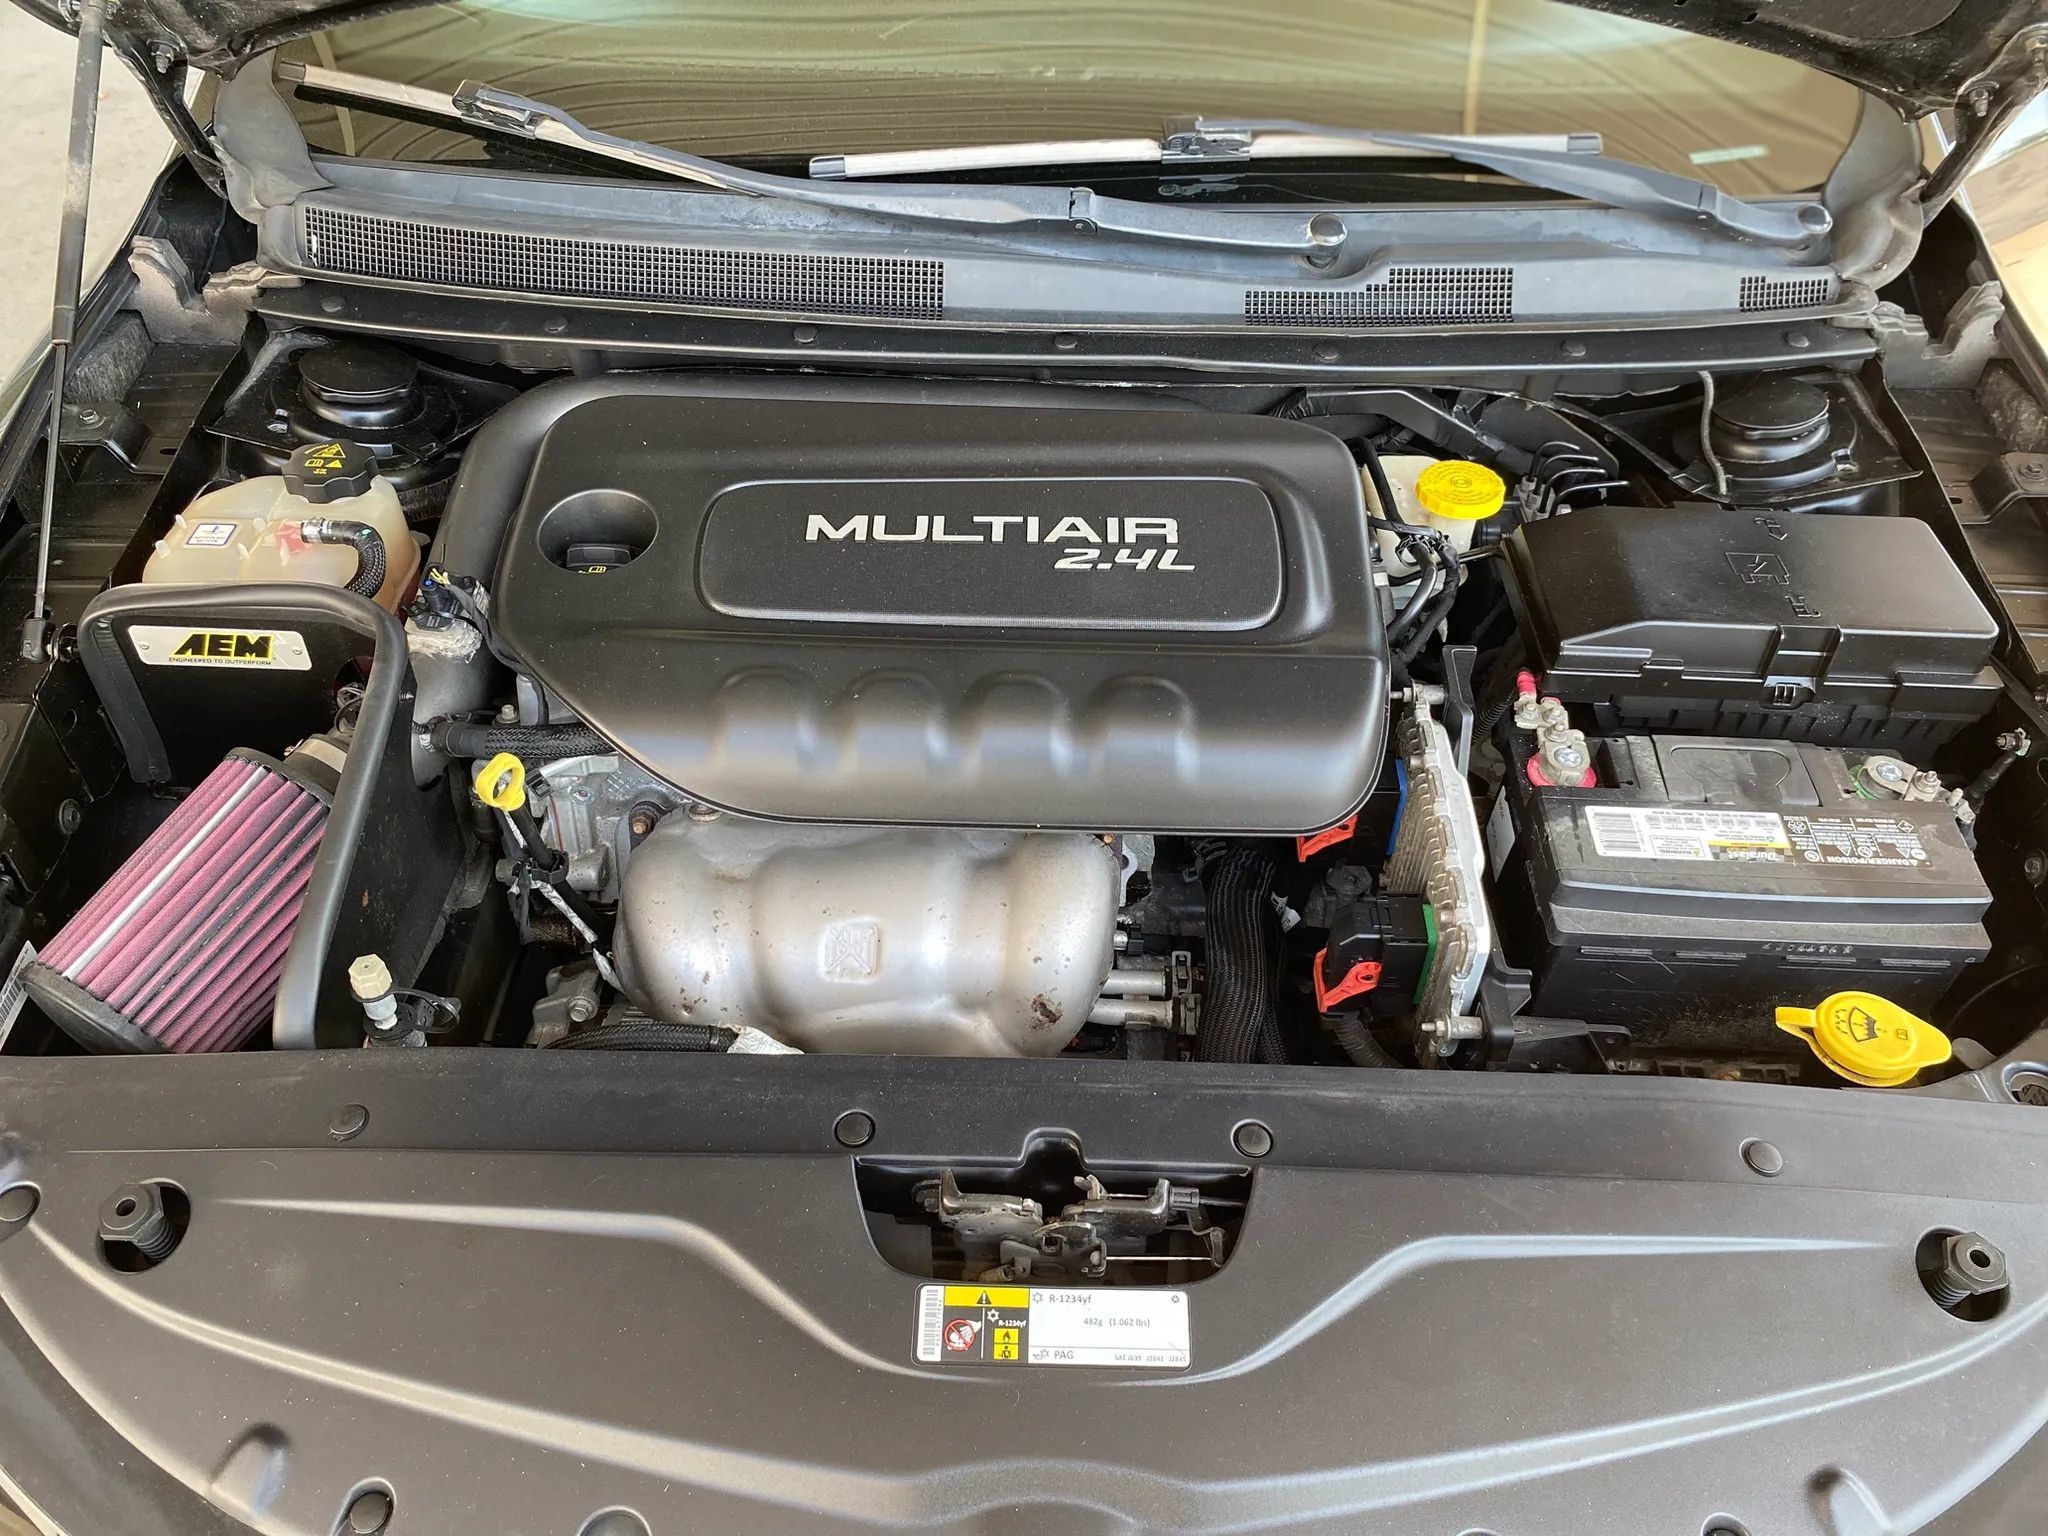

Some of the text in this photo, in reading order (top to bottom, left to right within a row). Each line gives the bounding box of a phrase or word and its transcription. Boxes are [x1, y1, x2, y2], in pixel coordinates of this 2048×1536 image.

[805, 514, 1179, 544] MULTIAIR
[1053, 548, 1196, 572] 2.4L
[172, 632, 274, 659] AEM
[1826, 855, 1910, 866] DANGER/POISON
[1049, 1294, 1092, 1305] R-1234yf
[998, 1319, 1027, 1328] R-1234yf
[1083, 1317, 1103, 1327] 482g
[1135, 1318, 1151, 1328] lbs)
[1054, 1350, 1074, 1360] PAG
